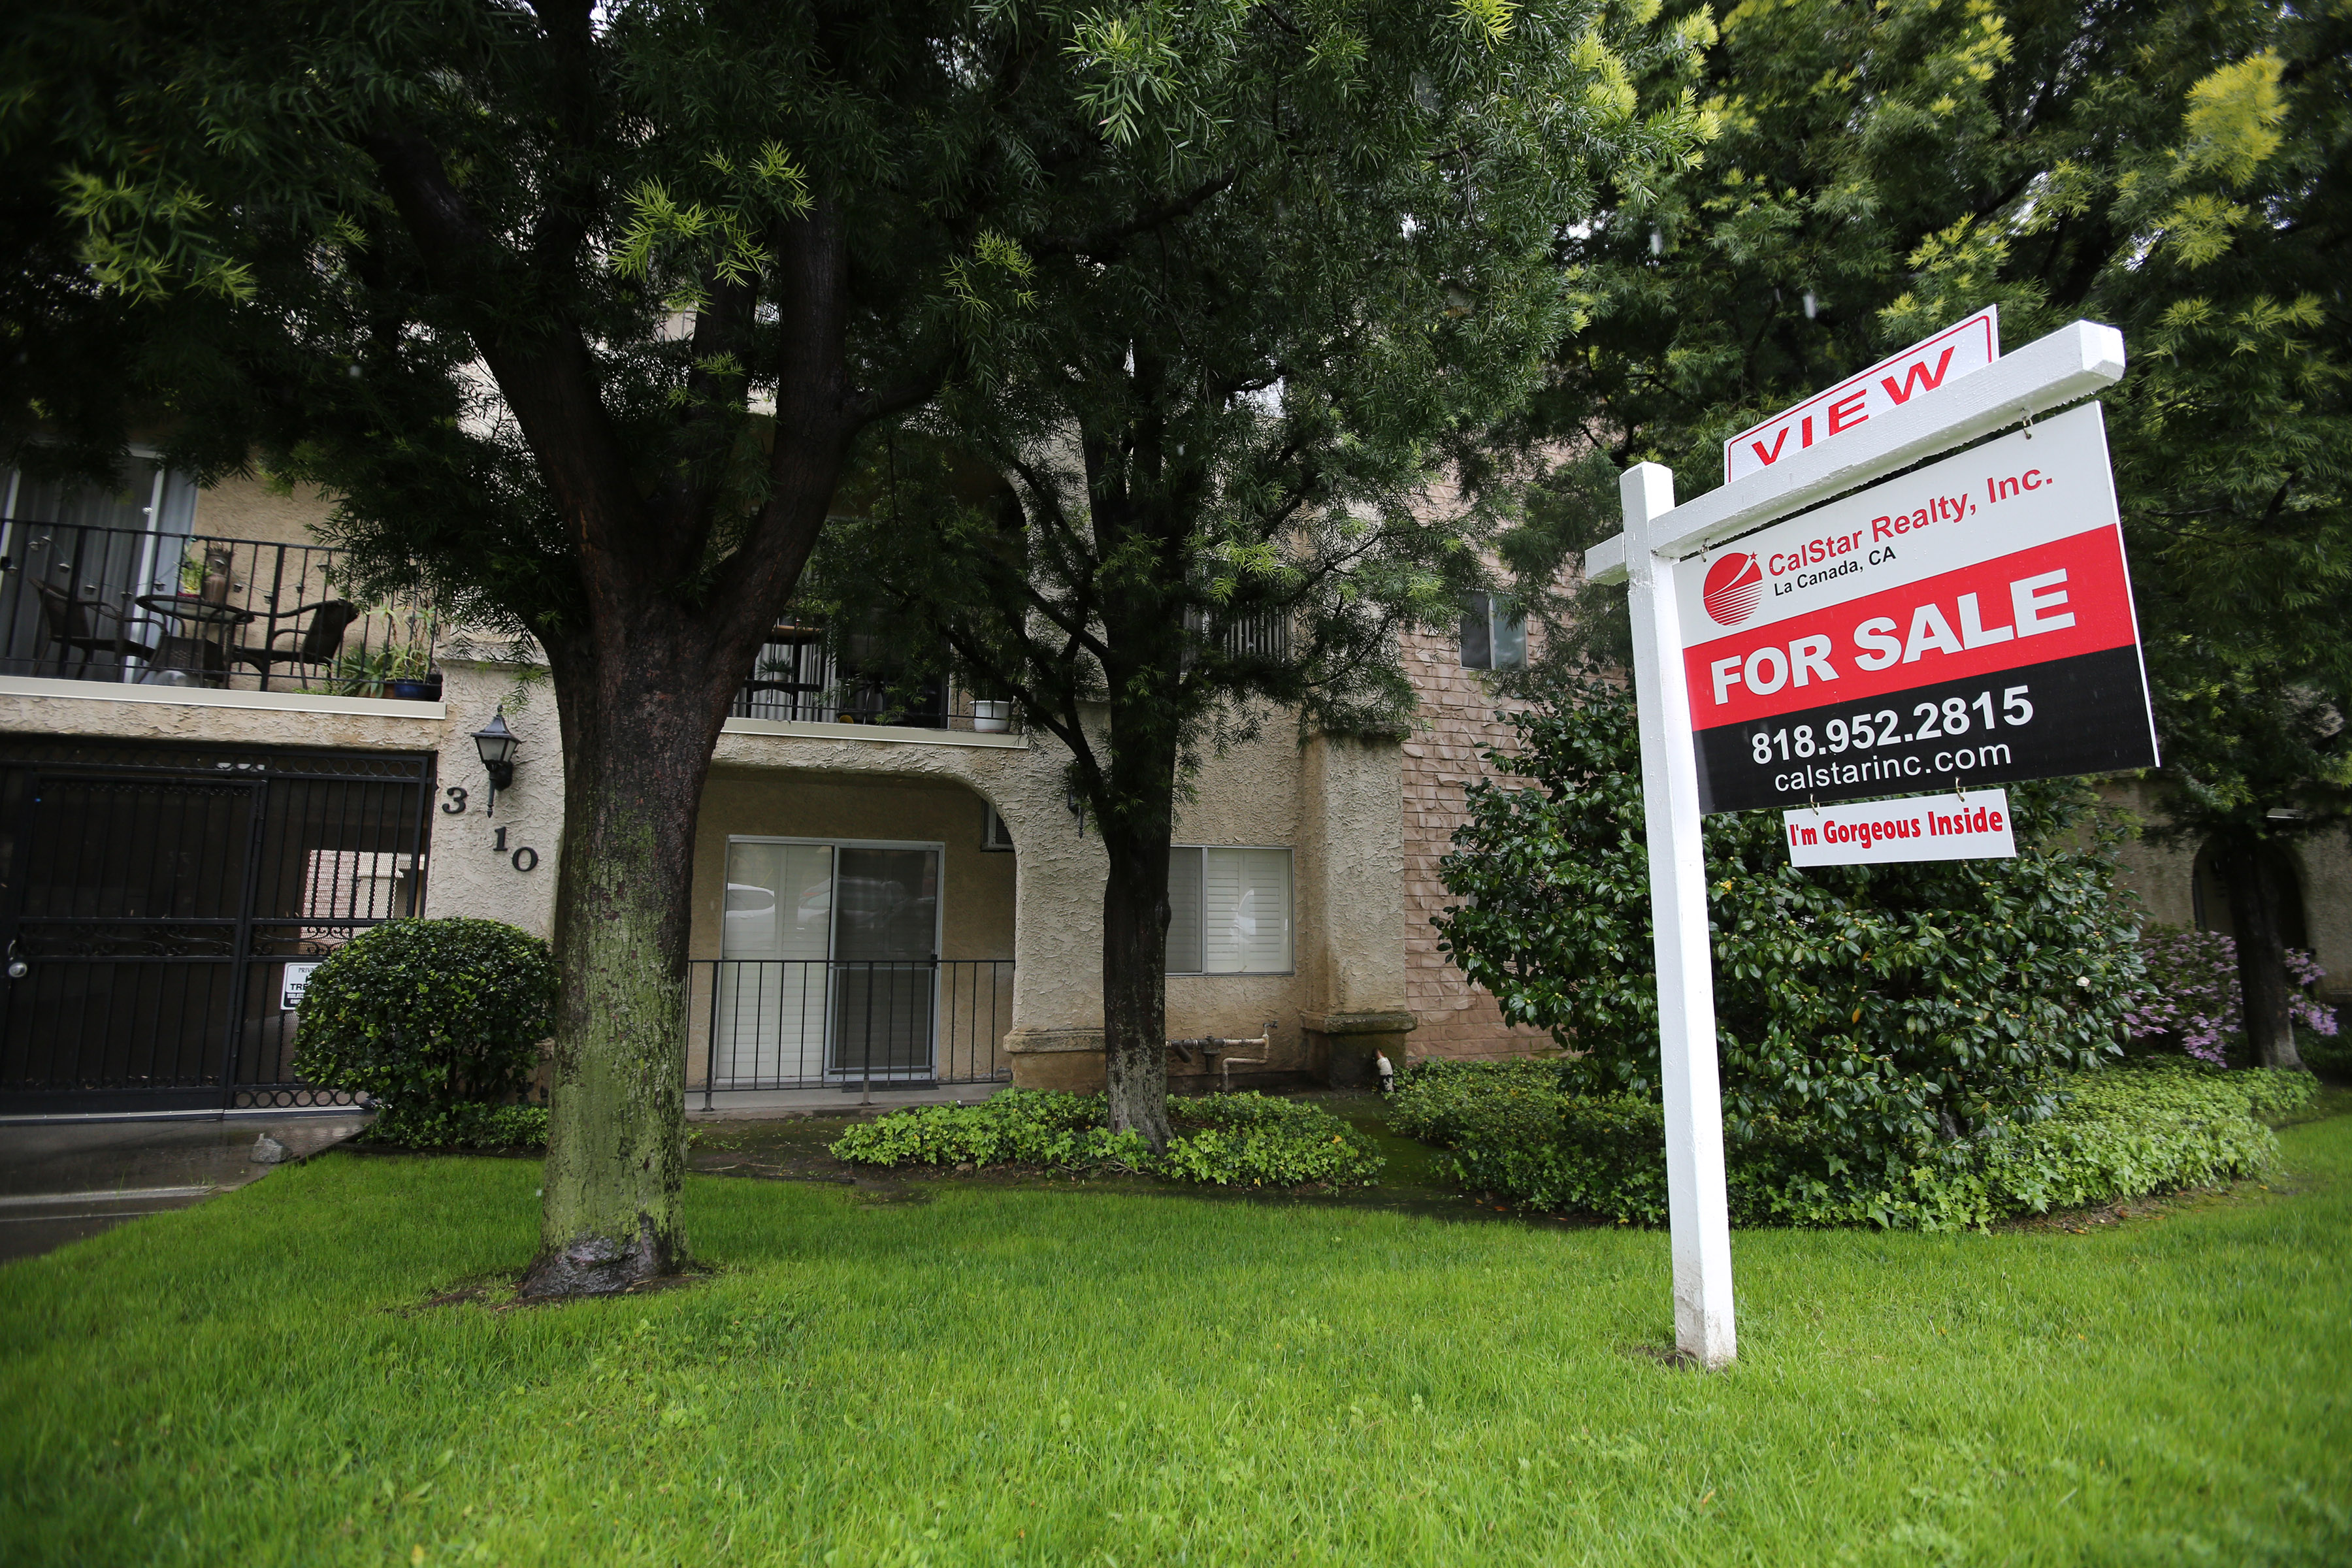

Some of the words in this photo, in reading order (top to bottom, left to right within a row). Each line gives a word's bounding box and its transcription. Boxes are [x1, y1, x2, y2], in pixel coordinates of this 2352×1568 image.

[1751, 346, 1955, 466] VIEW
[1769, 531, 1863, 577] CalStar
[1872, 493, 1976, 543] Realty,
[1987, 468, 2053, 504] Inc.
[1774, 582, 1793, 596] La
[1797, 560, 1864, 589] Canada,
[1869, 546, 1897, 566] CA
[1710, 634, 1840, 706] FOR
[1854, 568, 2076, 672] SALE
[1752, 685, 2033, 764] 818.952.2815
[1775, 743, 2011, 792] calstarinc.com
[1789, 824, 1818, 847] I'm
[1823, 818, 1921, 849] Gorgeous
[1928, 806, 2003, 836] Inside
